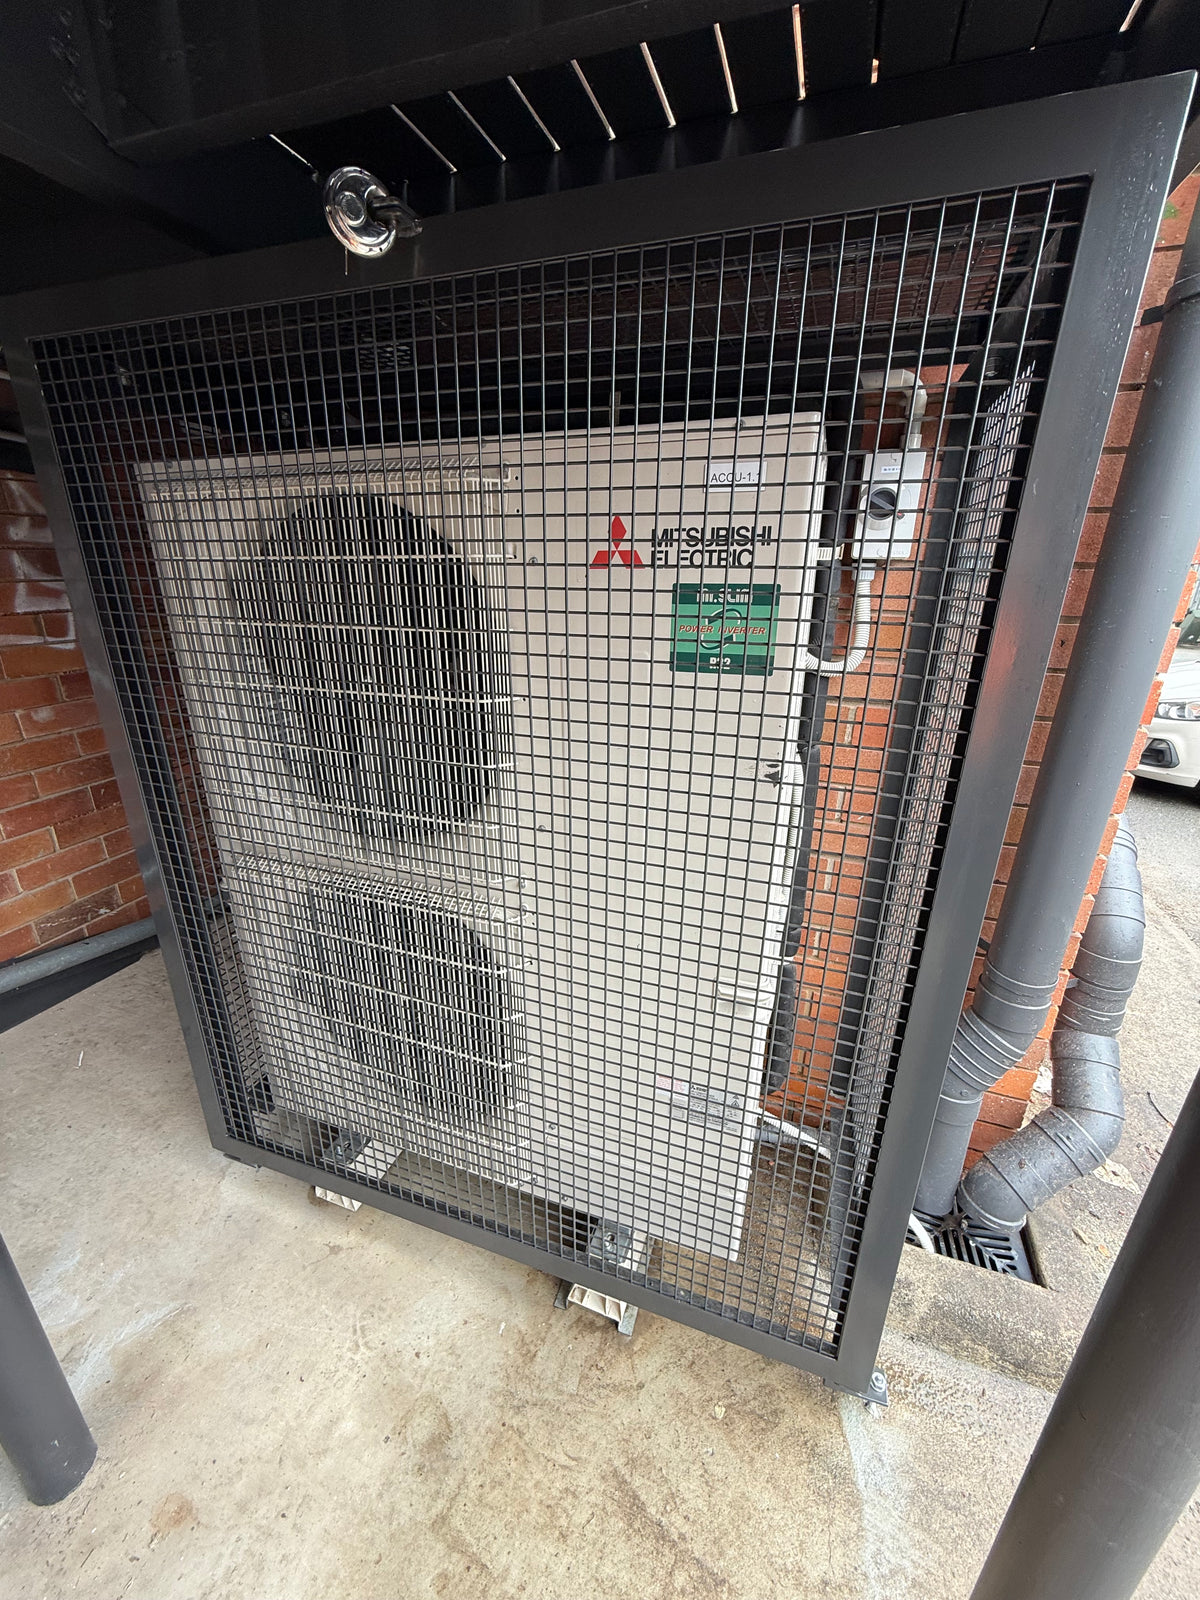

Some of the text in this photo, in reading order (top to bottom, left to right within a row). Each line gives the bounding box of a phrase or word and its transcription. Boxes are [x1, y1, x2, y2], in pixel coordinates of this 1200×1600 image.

[651, 525, 772, 548] MITSUBISHI
[651, 548, 753, 569] ELECTRIC
[679, 624, 766, 635] POWER INVERTER
